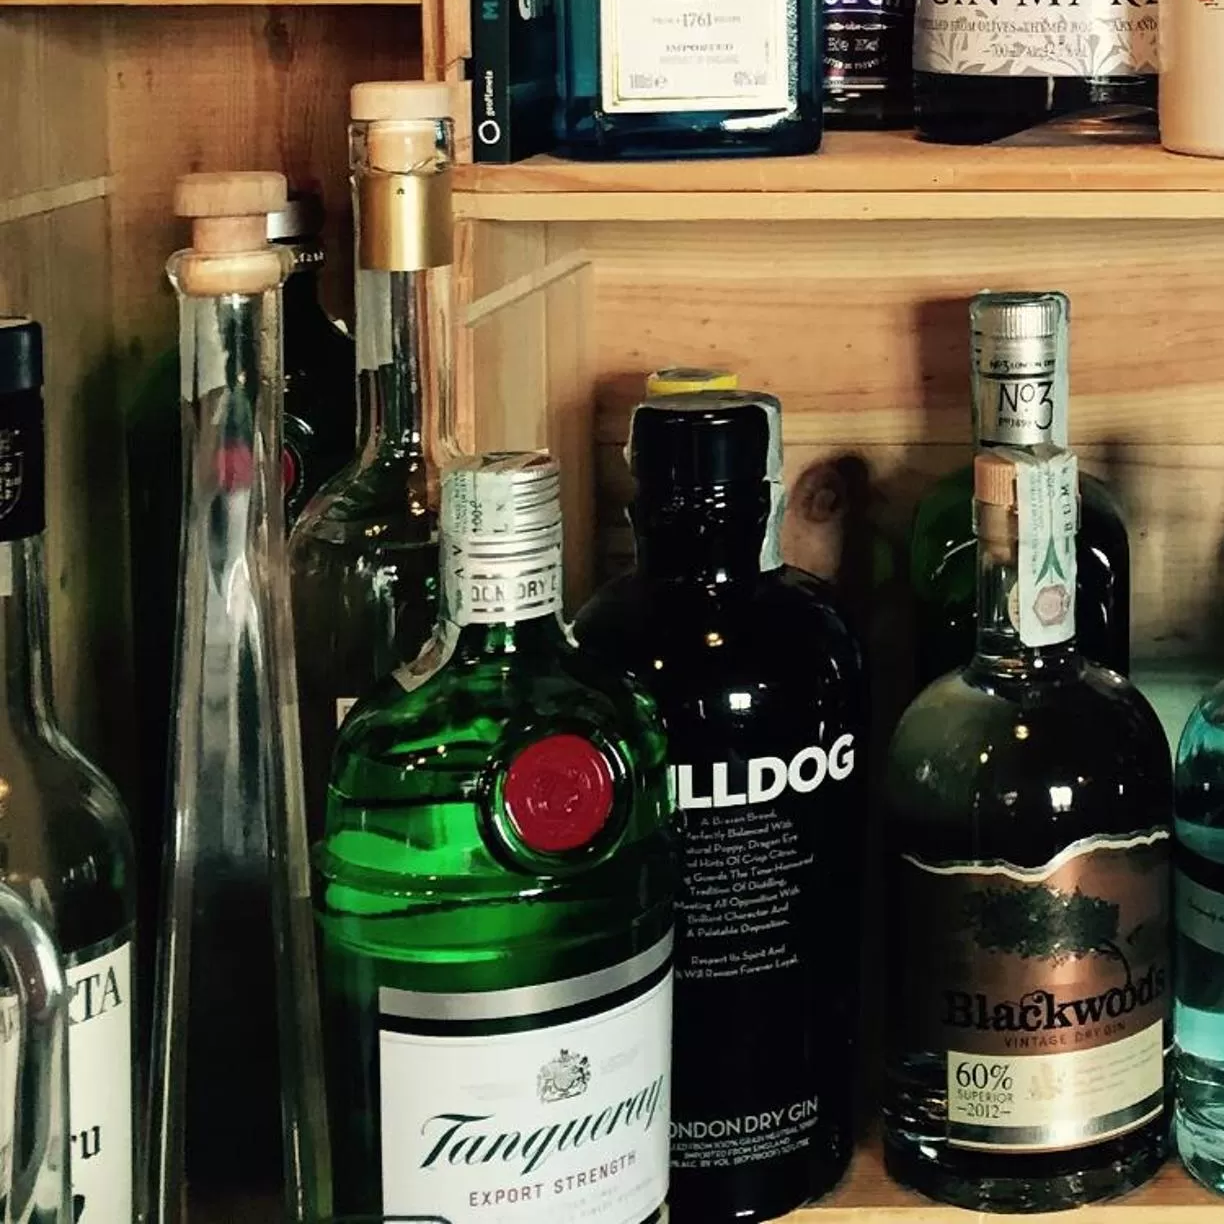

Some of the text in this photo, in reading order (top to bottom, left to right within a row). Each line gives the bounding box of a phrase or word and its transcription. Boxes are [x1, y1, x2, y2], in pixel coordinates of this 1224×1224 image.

[681, 12, 713, 27] 1761
[1004, 1036, 1067, 1049] VINTAGE
[1073, 1030, 1099, 1045] DRY
[955, 1061, 1014, 1092] 60%
[956, 1089, 1015, 1104] SUPERIOR
[420, 1075, 667, 1176] Tanqueray
[667, 1093, 819, 1139] ONDON DRY GIN
[469, 1151, 637, 1208] EXPORT STRENGTH
